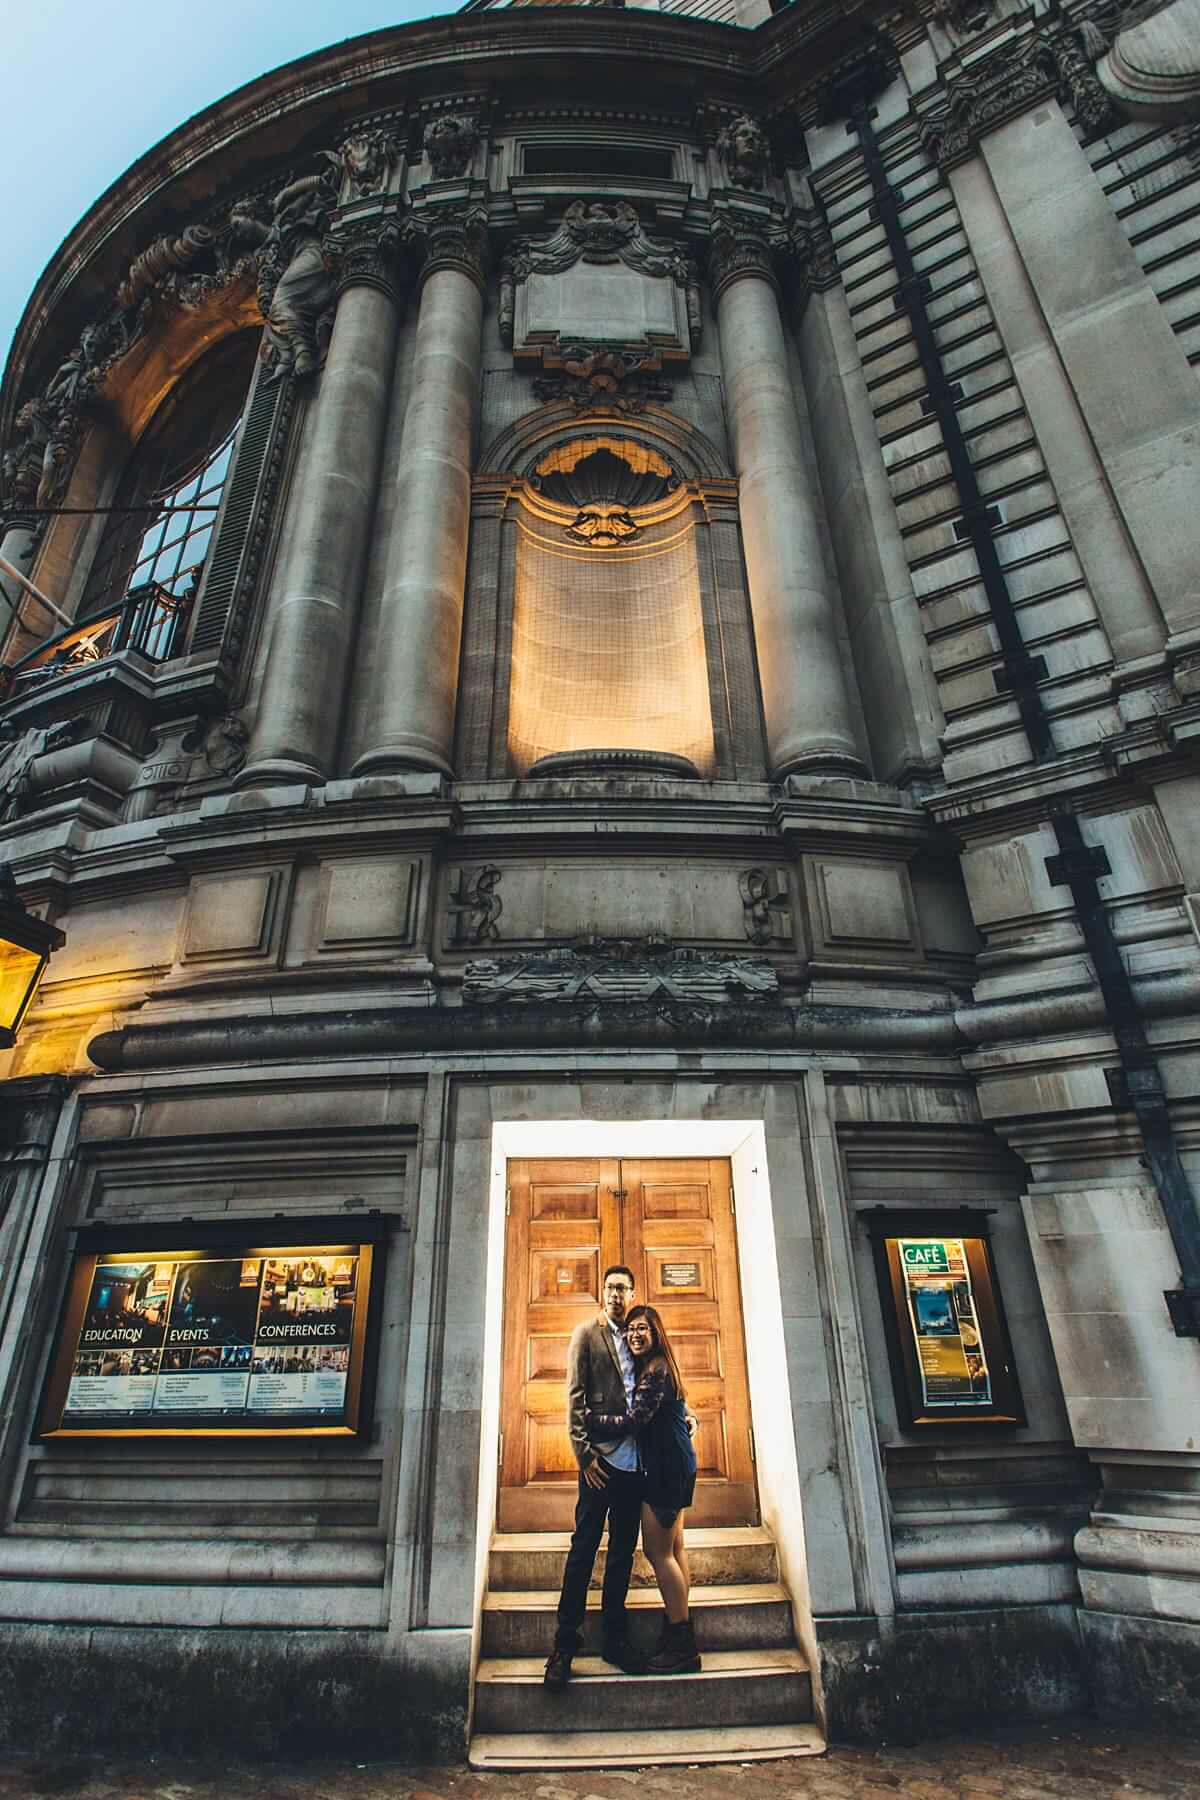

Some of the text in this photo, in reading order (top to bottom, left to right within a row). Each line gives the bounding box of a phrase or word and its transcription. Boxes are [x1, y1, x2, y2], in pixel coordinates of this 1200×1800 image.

[904, 1245, 941, 1263] CAFÉ
[84, 1328, 143, 1342] EDUCATION
[169, 1328, 209, 1341] EVENTS
[259, 1324, 337, 1337] CONFERENCES
